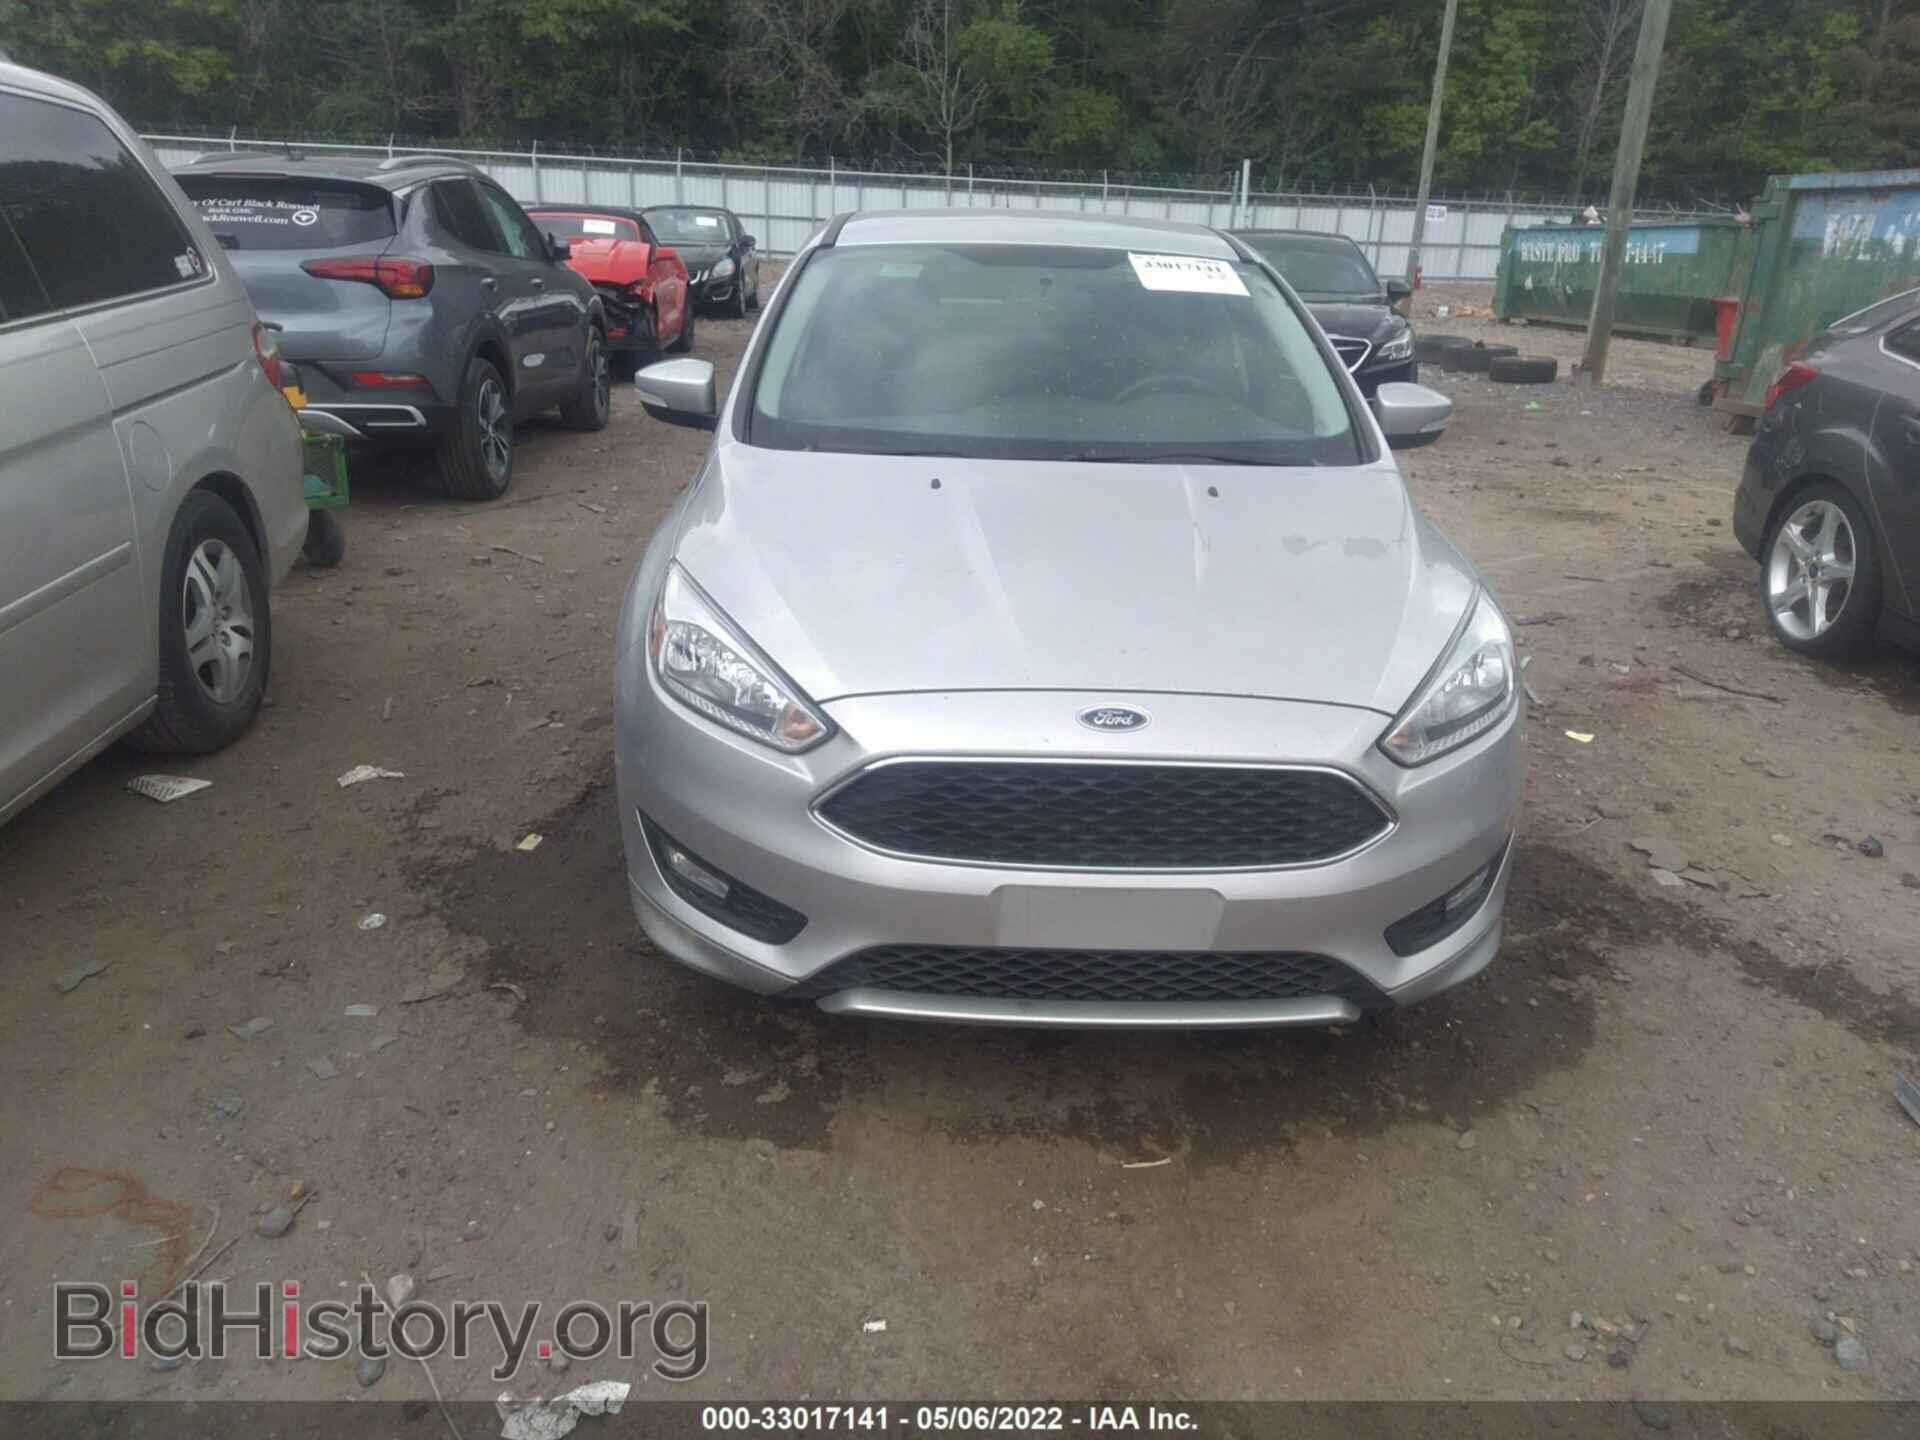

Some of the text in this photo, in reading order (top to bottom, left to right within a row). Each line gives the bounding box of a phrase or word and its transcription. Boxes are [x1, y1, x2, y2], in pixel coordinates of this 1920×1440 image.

[202, 198, 217, 207] Of
[243, 199, 273, 209] Black
[276, 200, 320, 213] Roswell
[1093, 710, 1135, 726] Ford
